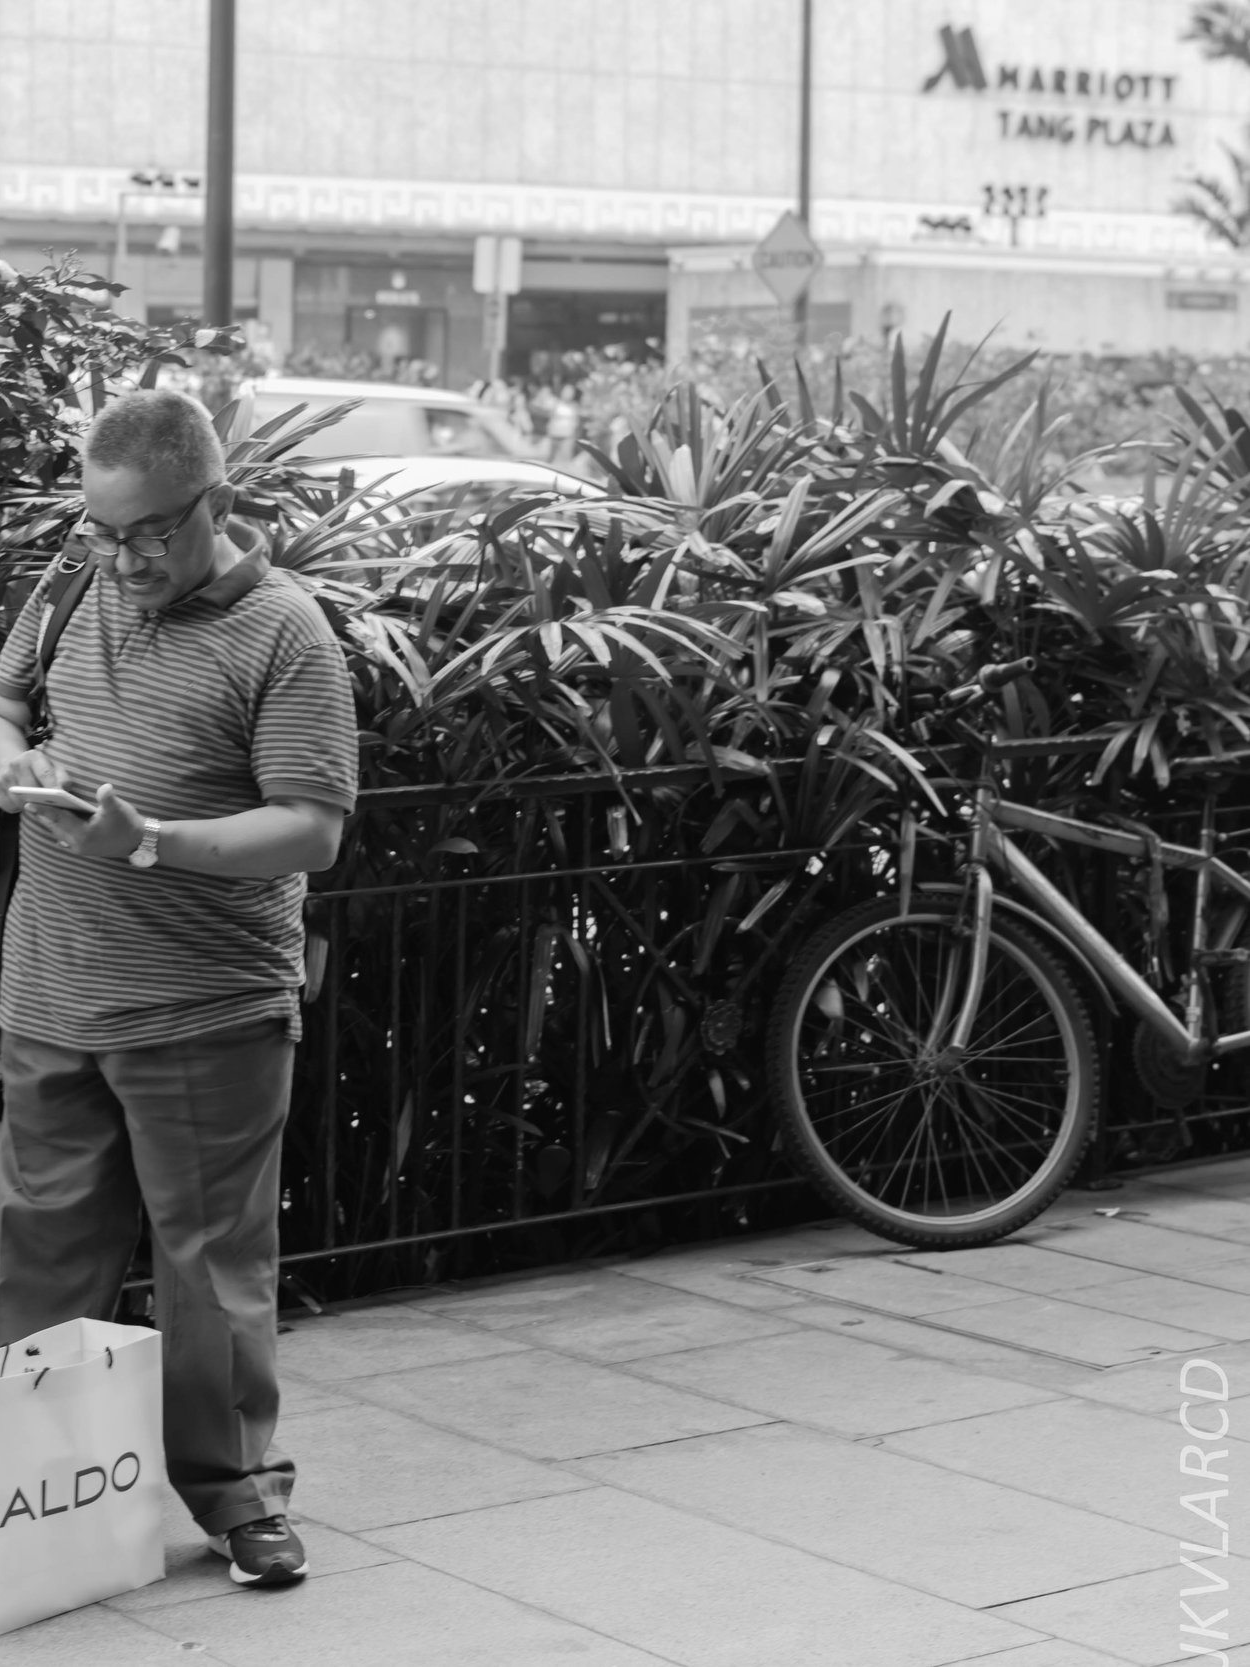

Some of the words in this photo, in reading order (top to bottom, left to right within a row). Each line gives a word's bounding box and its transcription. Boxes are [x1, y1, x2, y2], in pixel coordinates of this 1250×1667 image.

[998, 64, 1176, 100] MARRIOTT
[998, 110, 1075, 144] TANG
[1087, 116, 1175, 148] PLAZA
[0, 1452, 140, 1528] ALDO
